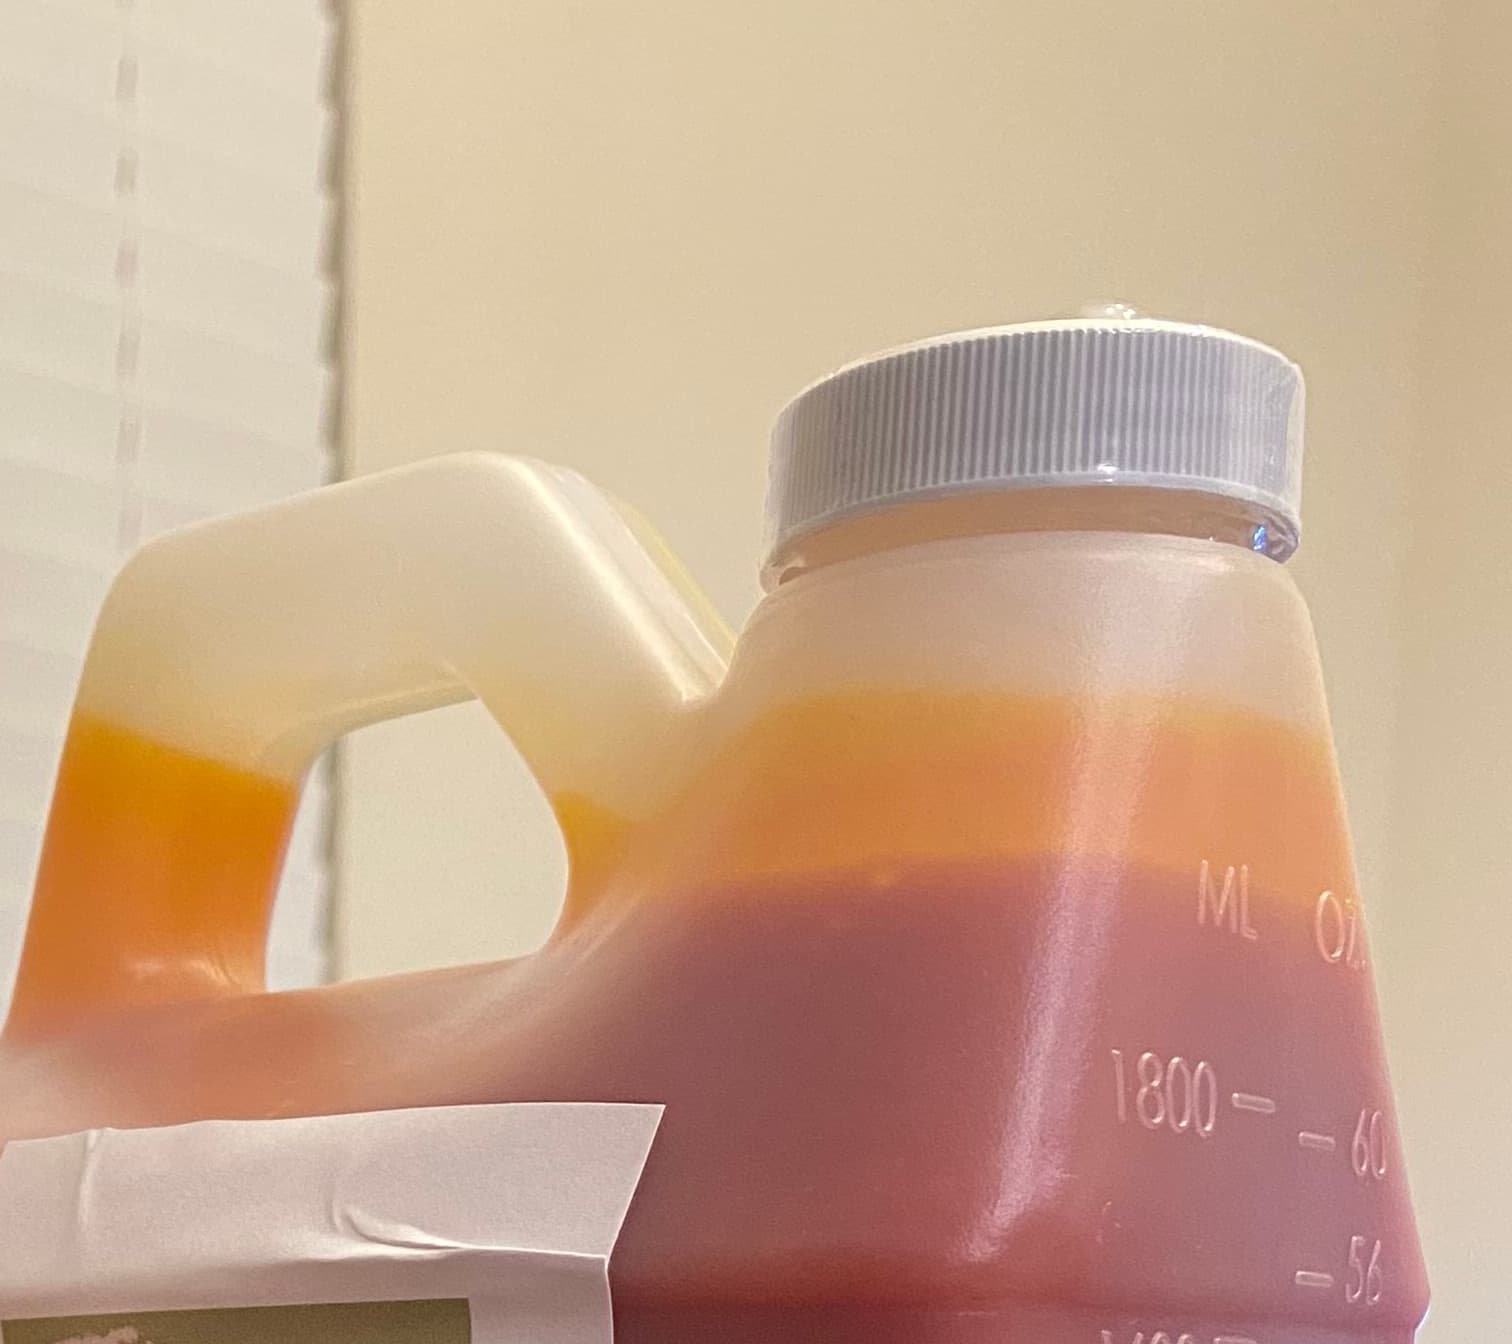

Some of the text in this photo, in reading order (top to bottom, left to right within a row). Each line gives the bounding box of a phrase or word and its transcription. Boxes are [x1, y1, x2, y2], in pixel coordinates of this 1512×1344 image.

[1197, 859, 1258, 940] ML
[1110, 1049, 1218, 1138] 1800
[1351, 1108, 1387, 1180] 60
[1345, 1234, 1383, 1305] 56
